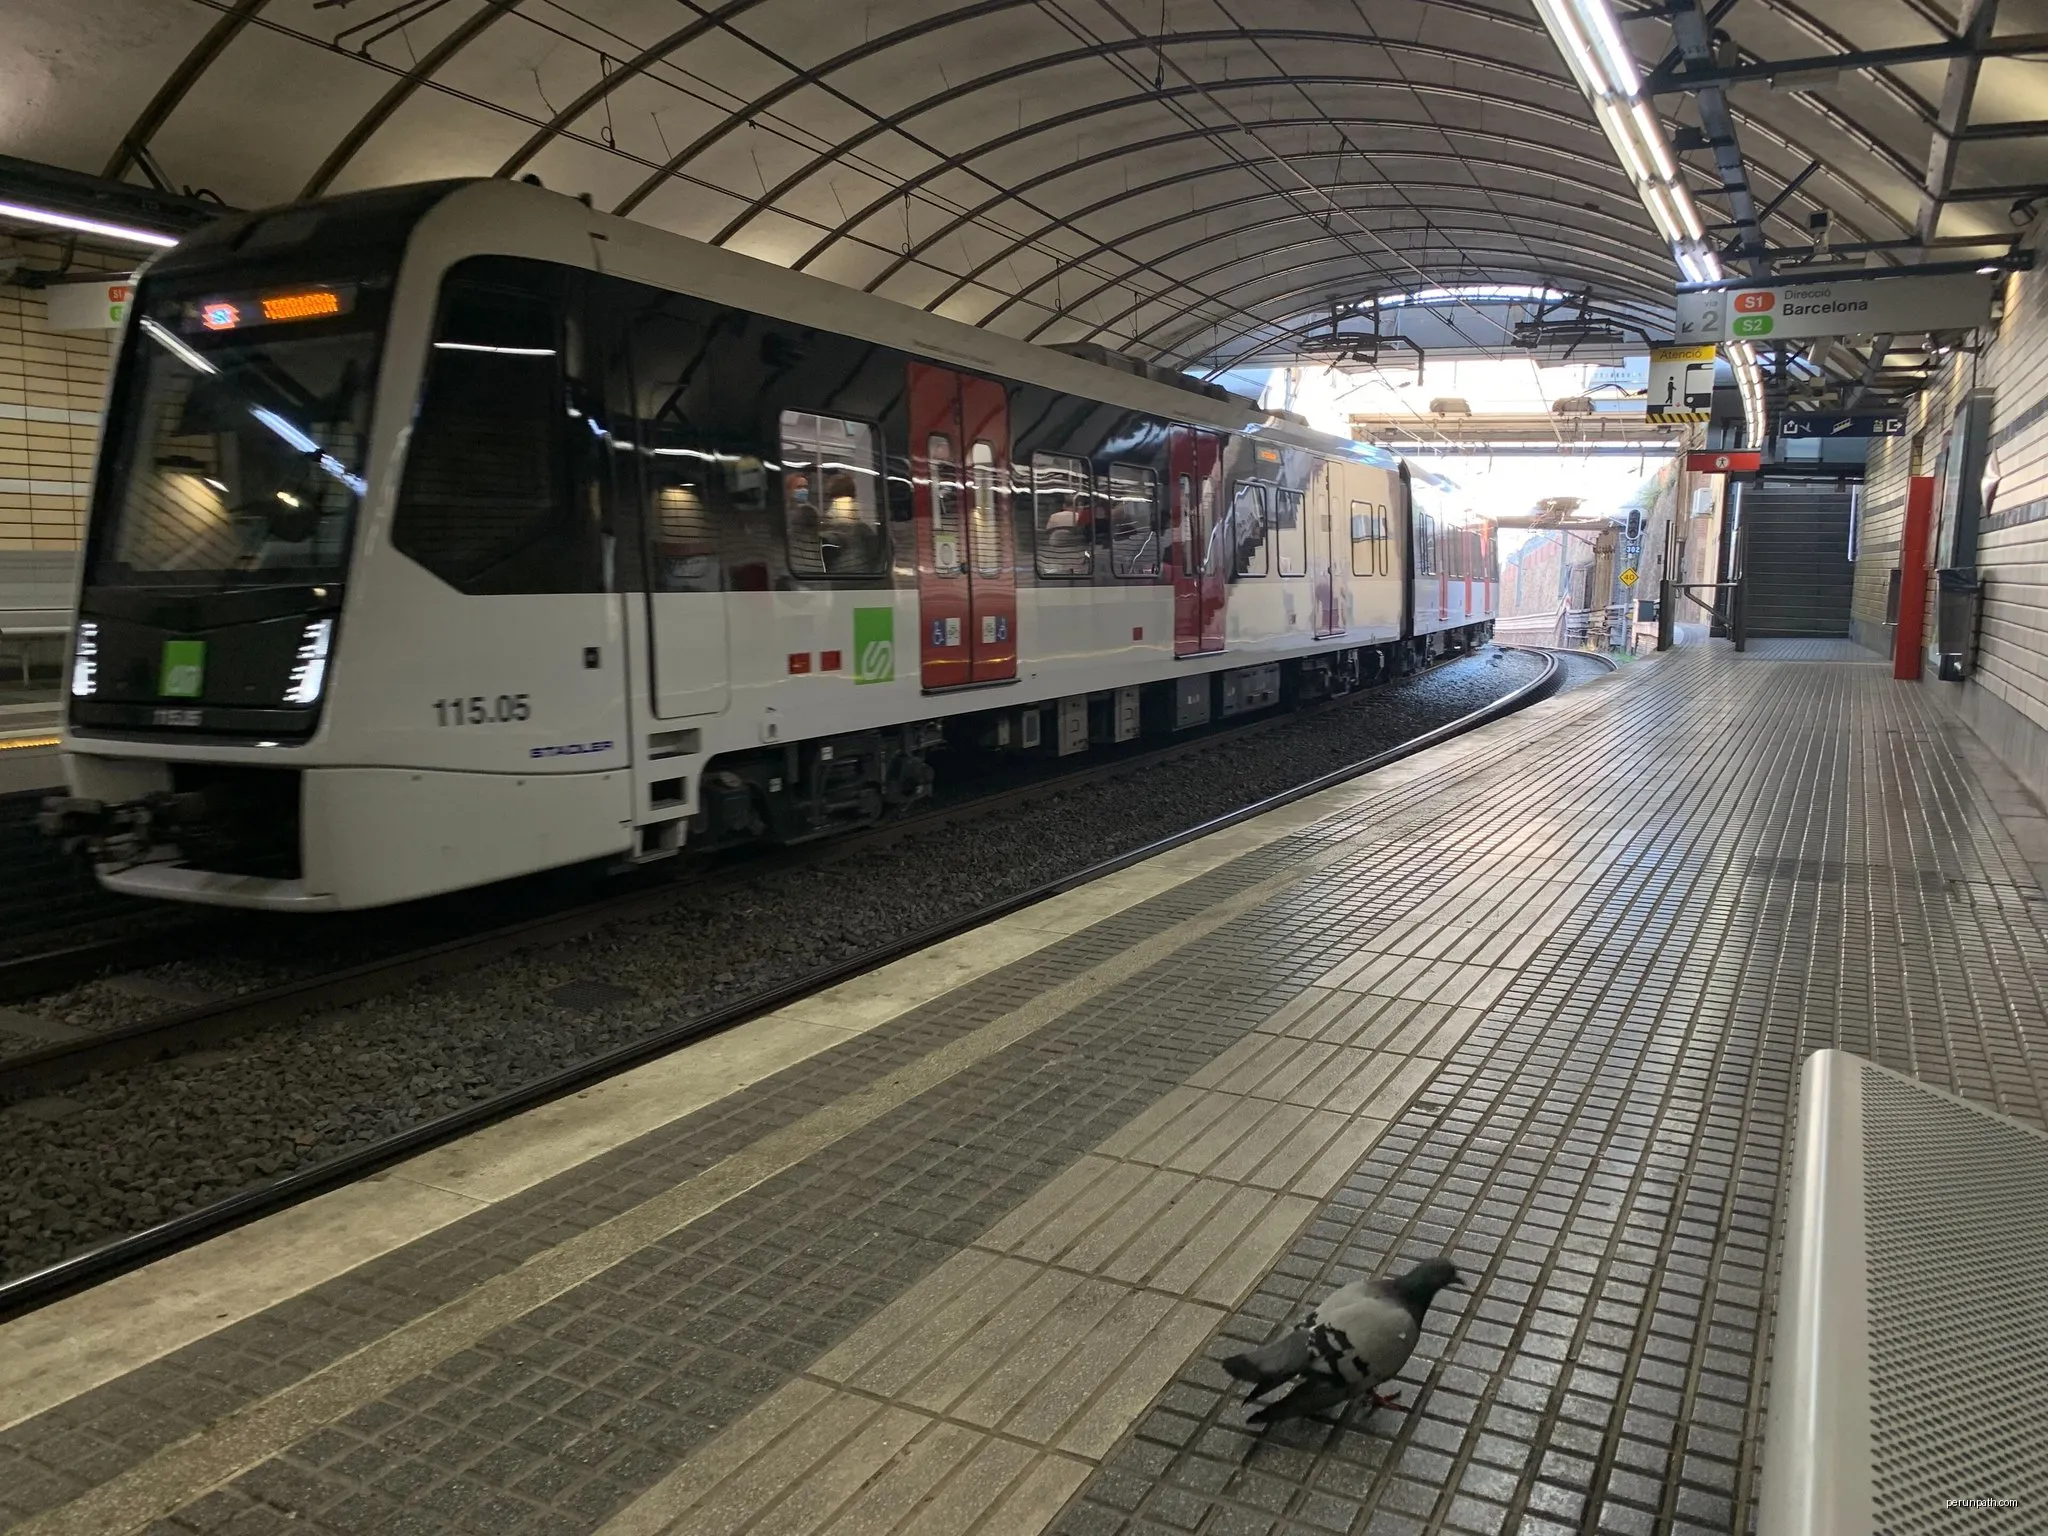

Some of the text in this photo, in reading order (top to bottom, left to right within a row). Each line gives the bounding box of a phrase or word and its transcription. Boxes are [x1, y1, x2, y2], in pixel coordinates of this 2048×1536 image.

[1784, 288, 1831, 300] Direcció
[1744, 296, 1763, 309] S1
[1782, 299, 1868, 316] Barcelona
[1701, 310, 1719, 333] 2
[1742, 319, 1764, 333] S2
[1660, 349, 1703, 360] Atenció
[1623, 573, 1635, 581] 40
[432, 693, 532, 727] 115.05
[529, 740, 614, 759] STADLER
